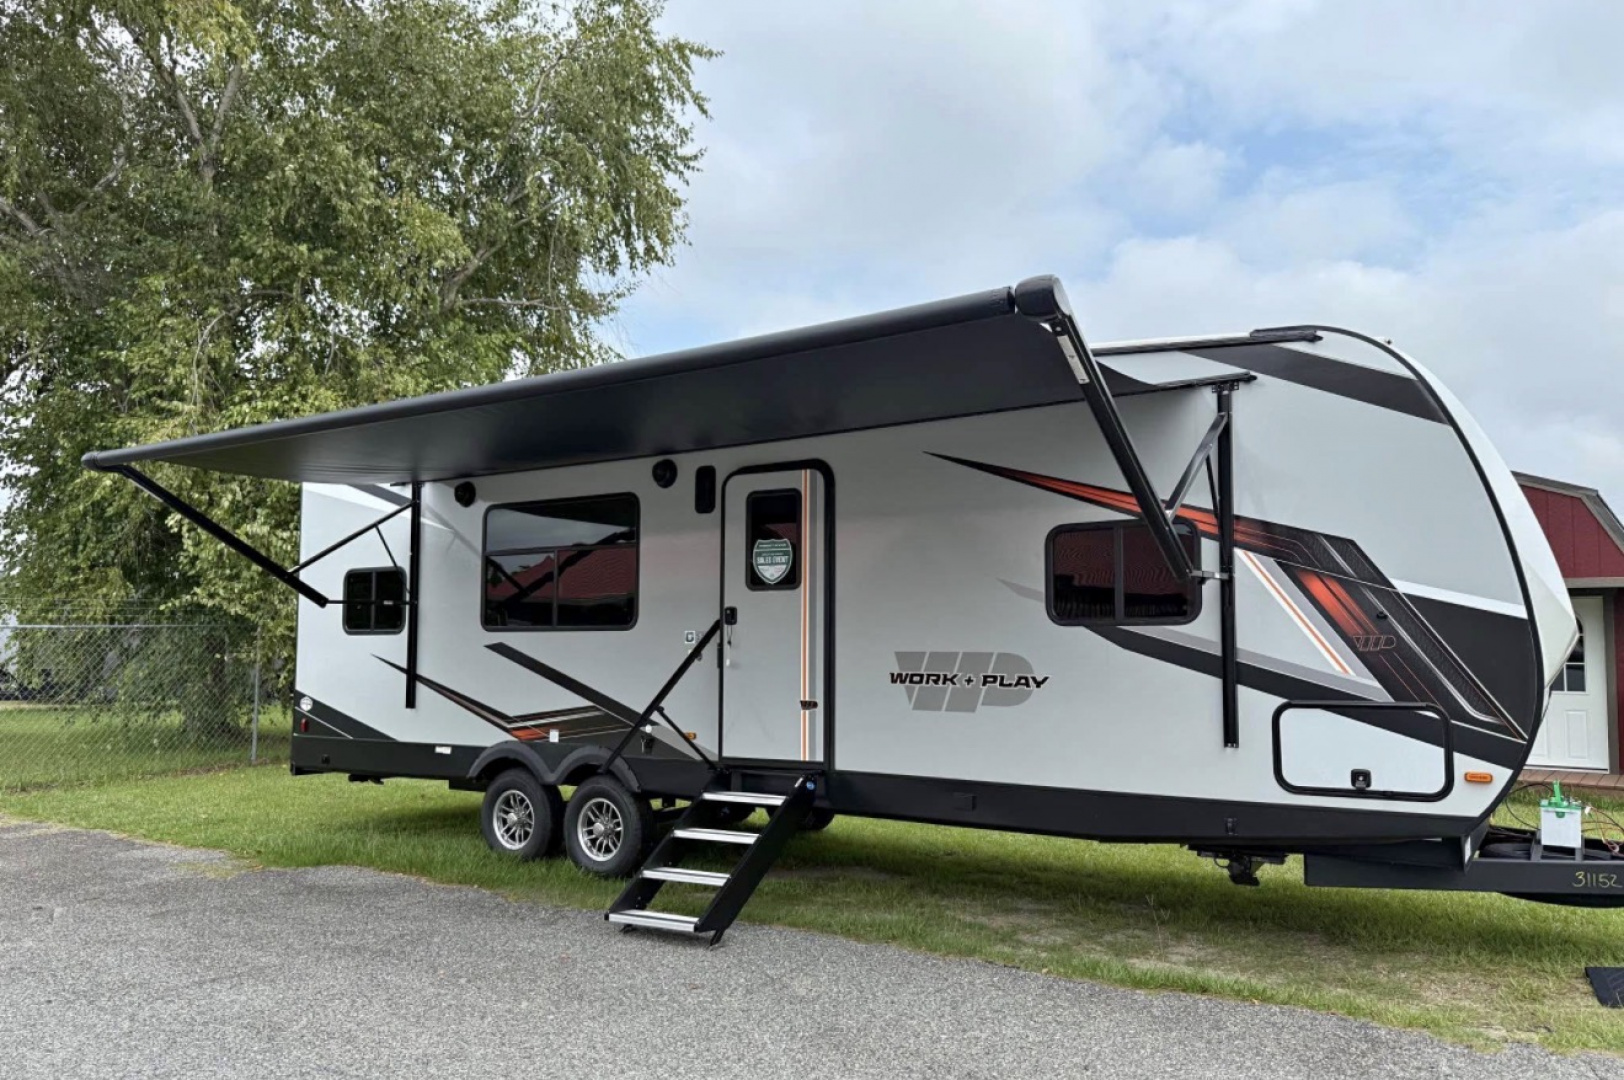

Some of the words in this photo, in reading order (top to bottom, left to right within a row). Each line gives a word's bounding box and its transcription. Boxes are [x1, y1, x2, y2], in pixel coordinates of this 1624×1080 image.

[889, 672, 959, 686] WORK
[981, 674, 1049, 688] PLAY
[1572, 871, 1623, 889] 31152
